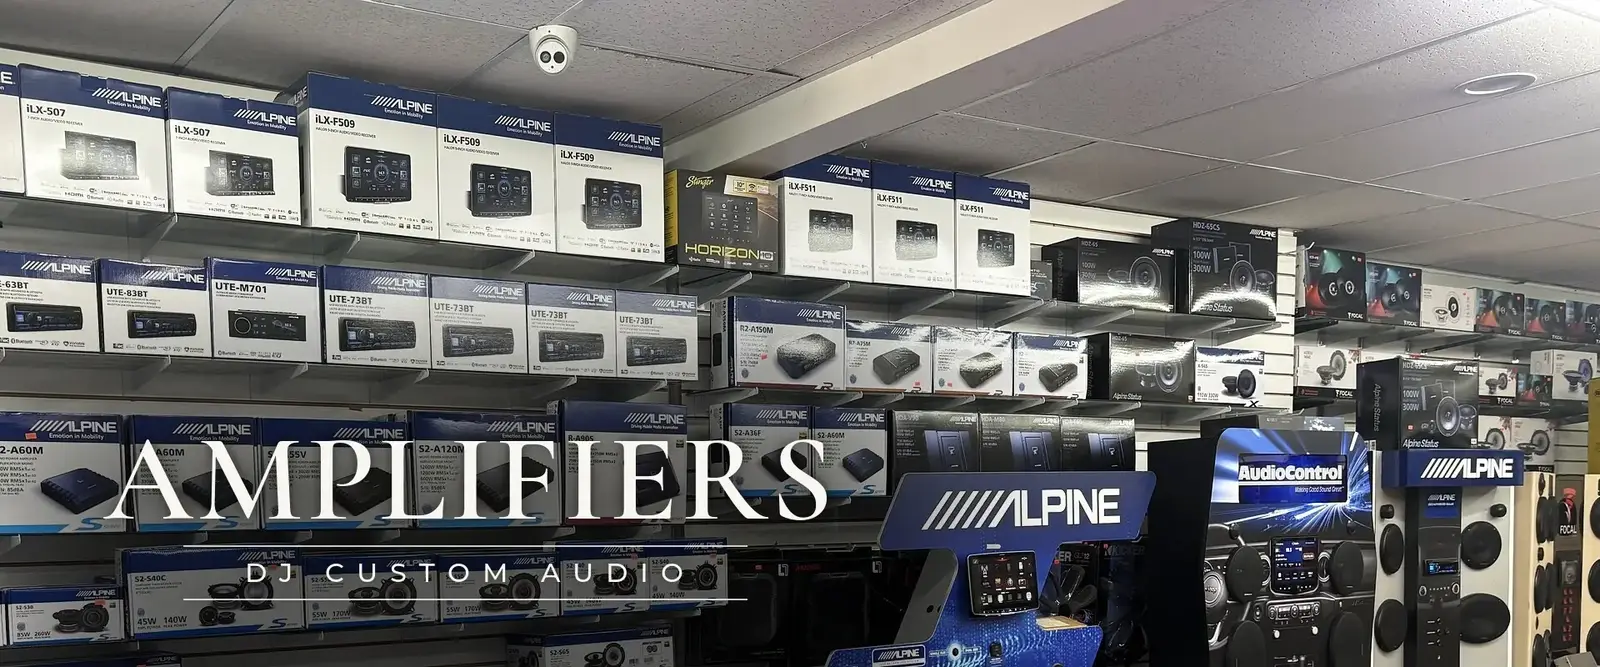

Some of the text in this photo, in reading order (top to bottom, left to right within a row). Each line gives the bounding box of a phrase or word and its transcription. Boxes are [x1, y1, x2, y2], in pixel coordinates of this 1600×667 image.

[114, 89, 162, 107] ALPINE
[26, 103, 66, 117] iLX-507
[391, 98, 433, 114] ALPINE
[253, 112, 296, 126] ALPINE
[315, 114, 355, 128] iLX-F509
[175, 125, 210, 136] iLX-507
[513, 118, 552, 132] ALPINE
[444, 134, 480, 147] iLX-F509
[626, 133, 661, 147] ALPINE
[560, 150, 595, 162] iLX-F509
[840, 166, 870, 178] ALPINE
[685, 175, 714, 189] Stinger
[788, 182, 816, 192] iLX-F511
[926, 180, 952, 190] ALPINE
[876, 193, 902, 204] iLX-F511
[1005, 190, 1029, 200] ALPINE
[960, 204, 984, 214] iLX-F511
[1192, 221, 1221, 231] HDZ-65CS
[1259, 229, 1277, 238] ALPINE
[685, 242, 760, 260] HORIZON
[1192, 250, 1211, 260] 100W
[43, 262, 92, 276] ALPINE
[282, 269, 316, 278] ALPINE
[1192, 264, 1211, 273] 300W
[161, 272, 205, 284] ALPINE
[388, 278, 426, 288] ALPINE
[106, 288, 148, 298] UTE-83BT
[215, 282, 268, 294] UTE-M701
[489, 286, 523, 296] ALPINE
[329, 294, 372, 305] UTE-73BT
[583, 294, 614, 304] ALPINE
[667, 300, 696, 309] ALPINE
[434, 302, 474, 313] UTE-73BT
[1213, 302, 1233, 313] Status
[531, 310, 568, 319] UTE-73BT
[811, 310, 841, 320] ALPINE
[620, 316, 654, 325] UTE-73BT
[740, 324, 774, 334] R2-A150M
[1461, 365, 1478, 373] ALPINE
[1402, 390, 1420, 398] 100W
[1402, 402, 1420, 412] 300W
[643, 413, 685, 424] ALPINE
[772, 410, 808, 420] ALPINE
[852, 413, 885, 422] ALPINE
[60, 421, 117, 433] ALPINE
[198, 424, 252, 435] ALPINE
[509, 421, 556, 433] ALPINE
[357, 428, 404, 440] ALPINE
[1402, 438, 1440, 448] Alpine Status
[1238, 464, 1343, 481] AudioControl
[1451, 458, 1514, 479] ALPINE
[988, 488, 1121, 528] ALPINE
[1559, 524, 1577, 535] FOCAL
[137, 616, 188, 626] 45W 140W
[894, 648, 920, 659] ALPINE
